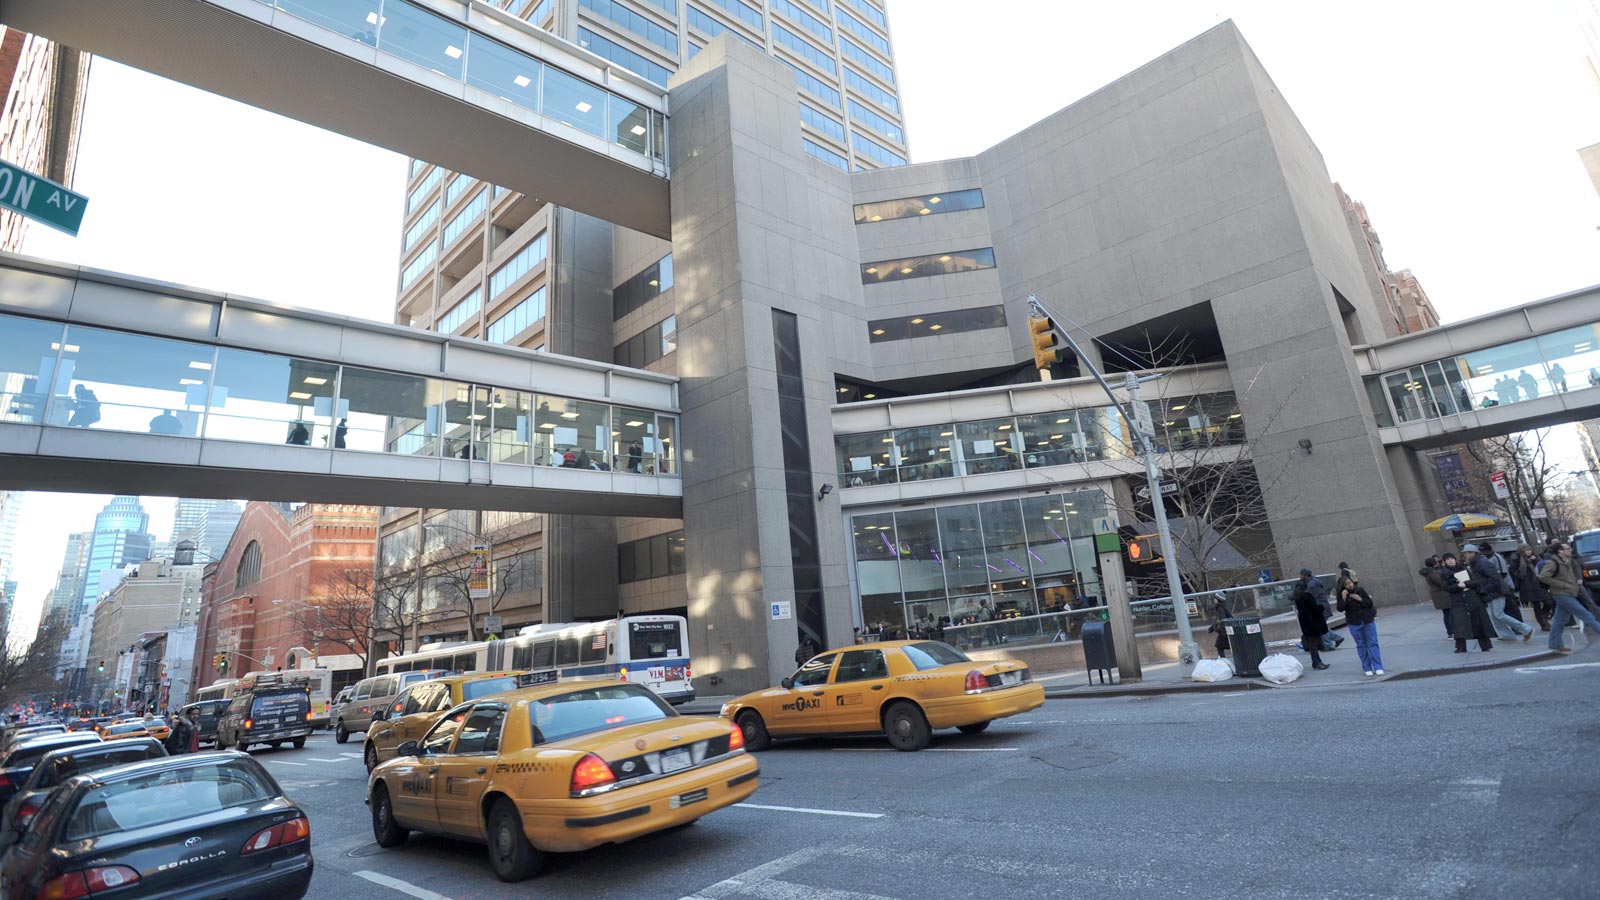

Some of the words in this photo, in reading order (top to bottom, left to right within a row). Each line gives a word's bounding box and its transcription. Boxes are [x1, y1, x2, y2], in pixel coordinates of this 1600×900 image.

[46, 190, 77, 212] AV
[782, 703, 795, 711] NYC
[796, 697, 820, 711] TAXI
[158, 850, 227, 871] COROLLA
